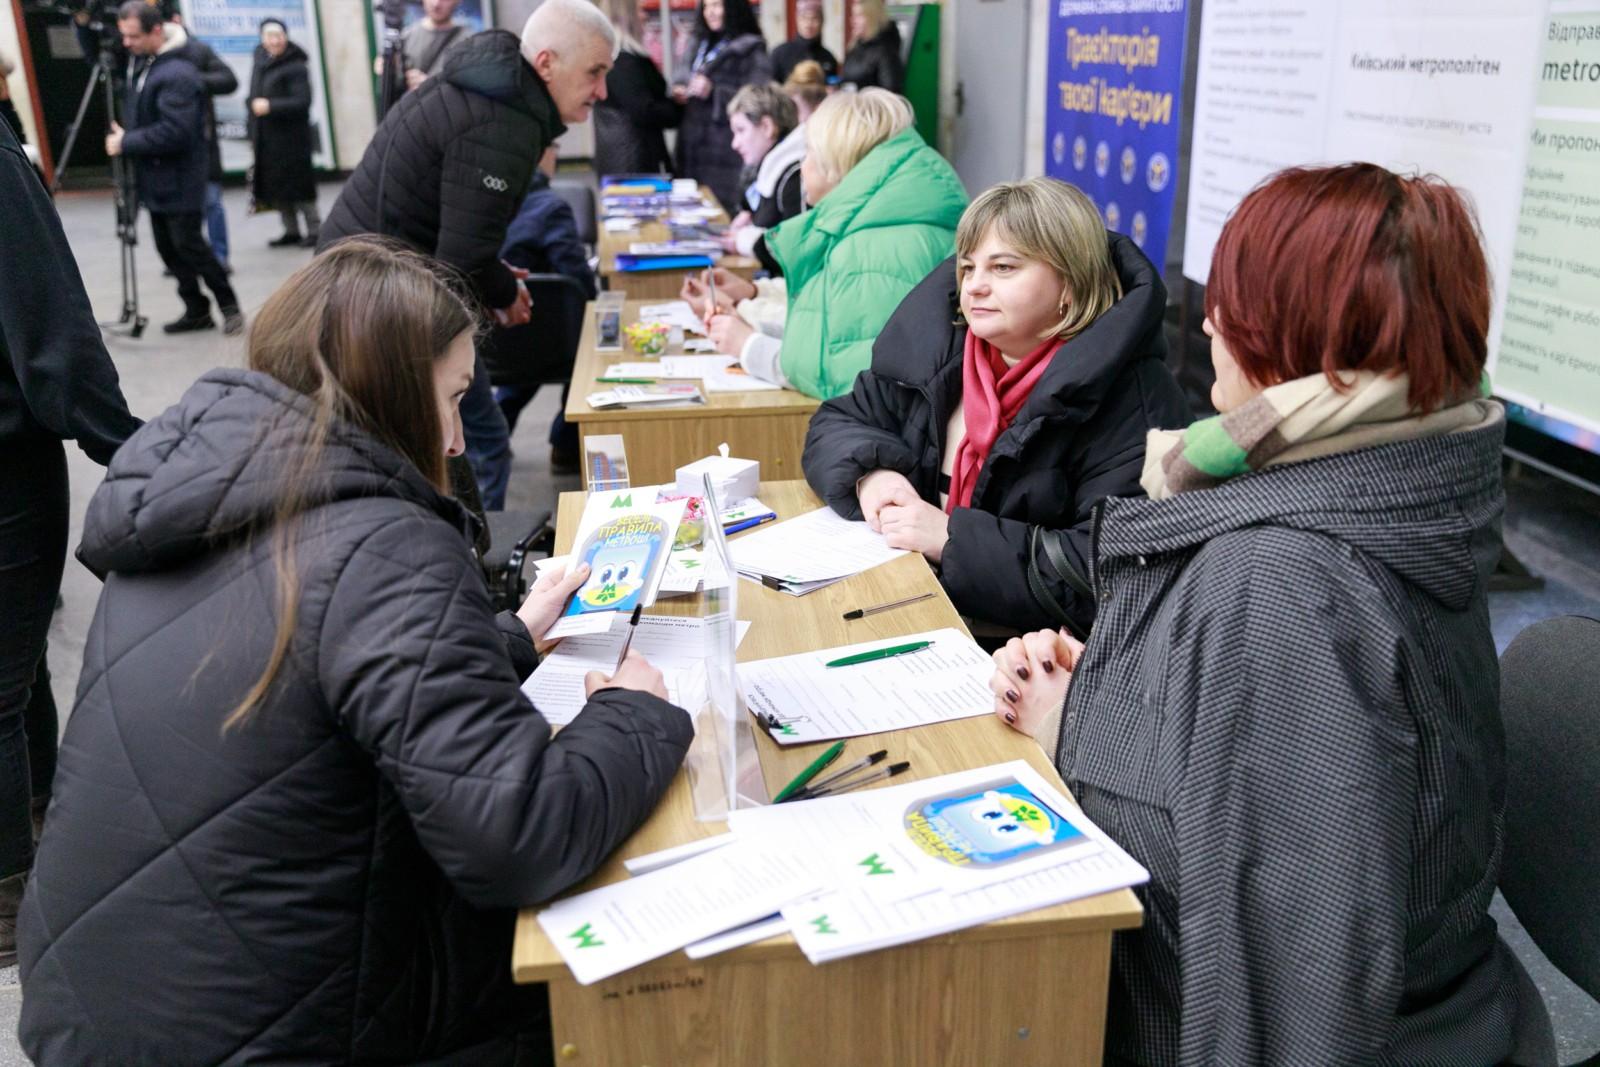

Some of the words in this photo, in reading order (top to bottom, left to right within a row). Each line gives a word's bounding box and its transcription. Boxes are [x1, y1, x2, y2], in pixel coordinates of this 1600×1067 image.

[1066, 26, 1159, 72] Траєкторія
[1409, 54, 1501, 80] метрополітен
[1542, 58, 1600, 82] metro
[598, 521, 663, 539] ПРАВИЛА
